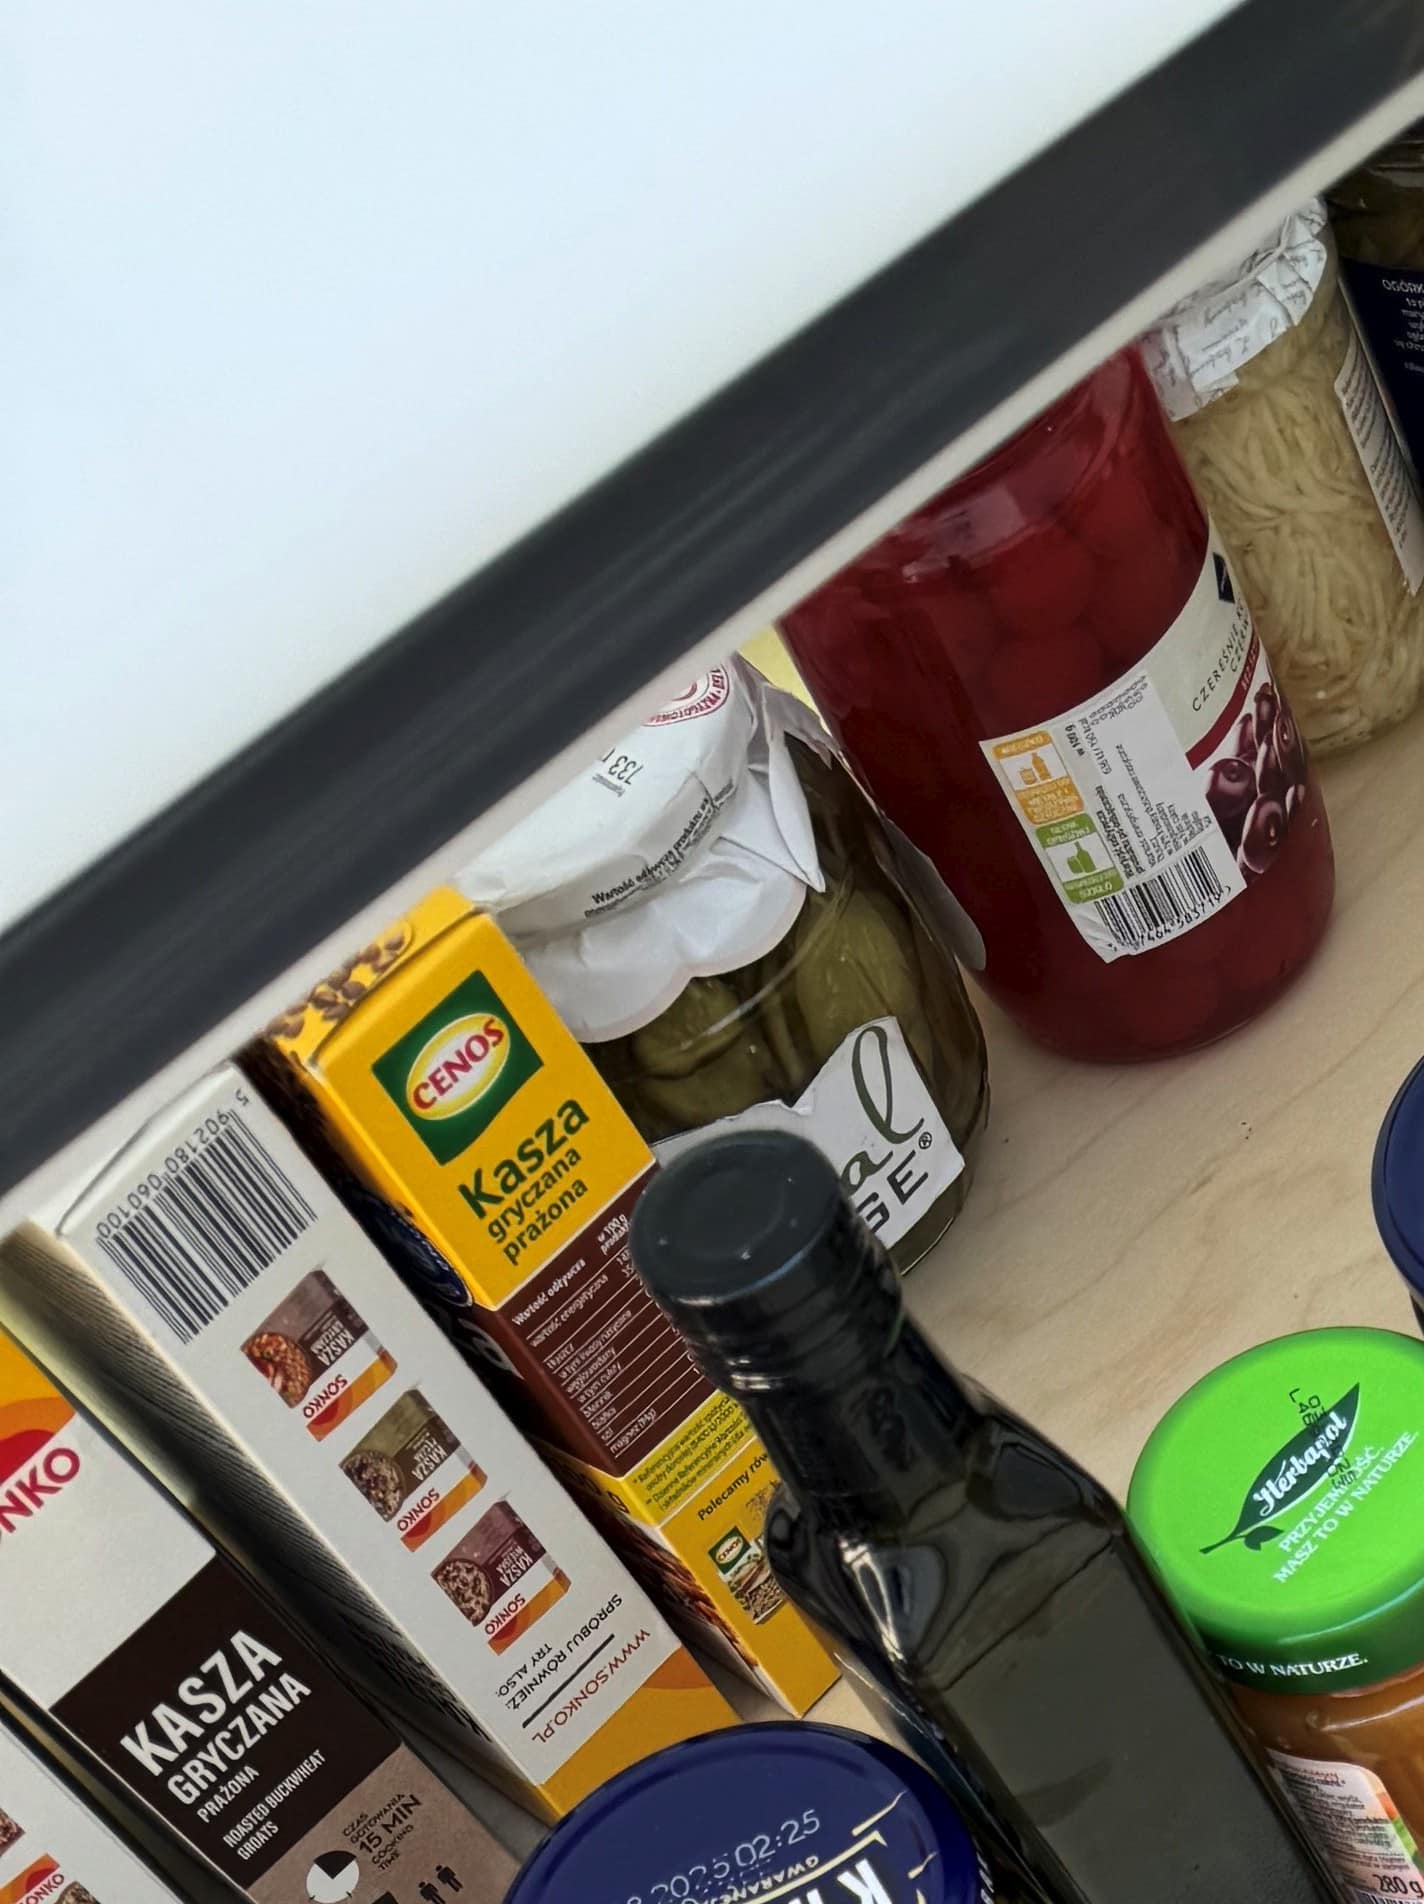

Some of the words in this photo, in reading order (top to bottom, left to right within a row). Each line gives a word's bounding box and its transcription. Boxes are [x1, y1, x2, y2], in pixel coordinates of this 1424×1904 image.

[409, 1016, 506, 1111] CENOS
[457, 1097, 594, 1222] Kasza
[486, 1149, 582, 1245] gryczana
[502, 1178, 590, 1267] prażona
[320, 1326, 357, 1368] KASZA
[301, 1373, 349, 1420] SONKO
[0, 1446, 80, 1537] NKO
[410, 1441, 450, 1482] KASZA
[396, 1487, 443, 1533] SONKO
[696, 1469, 750, 1521] Polecamy
[497, 1549, 535, 1587] KASZA
[1271, 1537, 1320, 1585] MASZ
[1312, 1512, 1341, 1542] TO
[1335, 1499, 1355, 1523] W
[483, 1591, 528, 1637] SONKO
[560, 1593, 624, 1657] SPRÓBUJ
[529, 1642, 554, 1669] TRY
[1246, 1660, 1267, 1676] W
[1268, 1651, 1369, 1678] NATURZE.
[120, 1626, 284, 1781] KASZA
[531, 1627, 652, 1746] WWW.SONKO.PL
[165, 1669, 312, 1810] GRYCZANA
[197, 1763, 261, 1824] PRAŻONA
[221, 1798, 270, 1850] ROASTED
[265, 1747, 329, 1814] BUCKWHEAT
[357, 1825, 385, 1854] 15
[376, 1793, 424, 1839] MIN
[236, 1820, 282, 1862] GROATS
[341, 1812, 371, 1839] CZAS
[731, 1807, 823, 1874] 02:25
